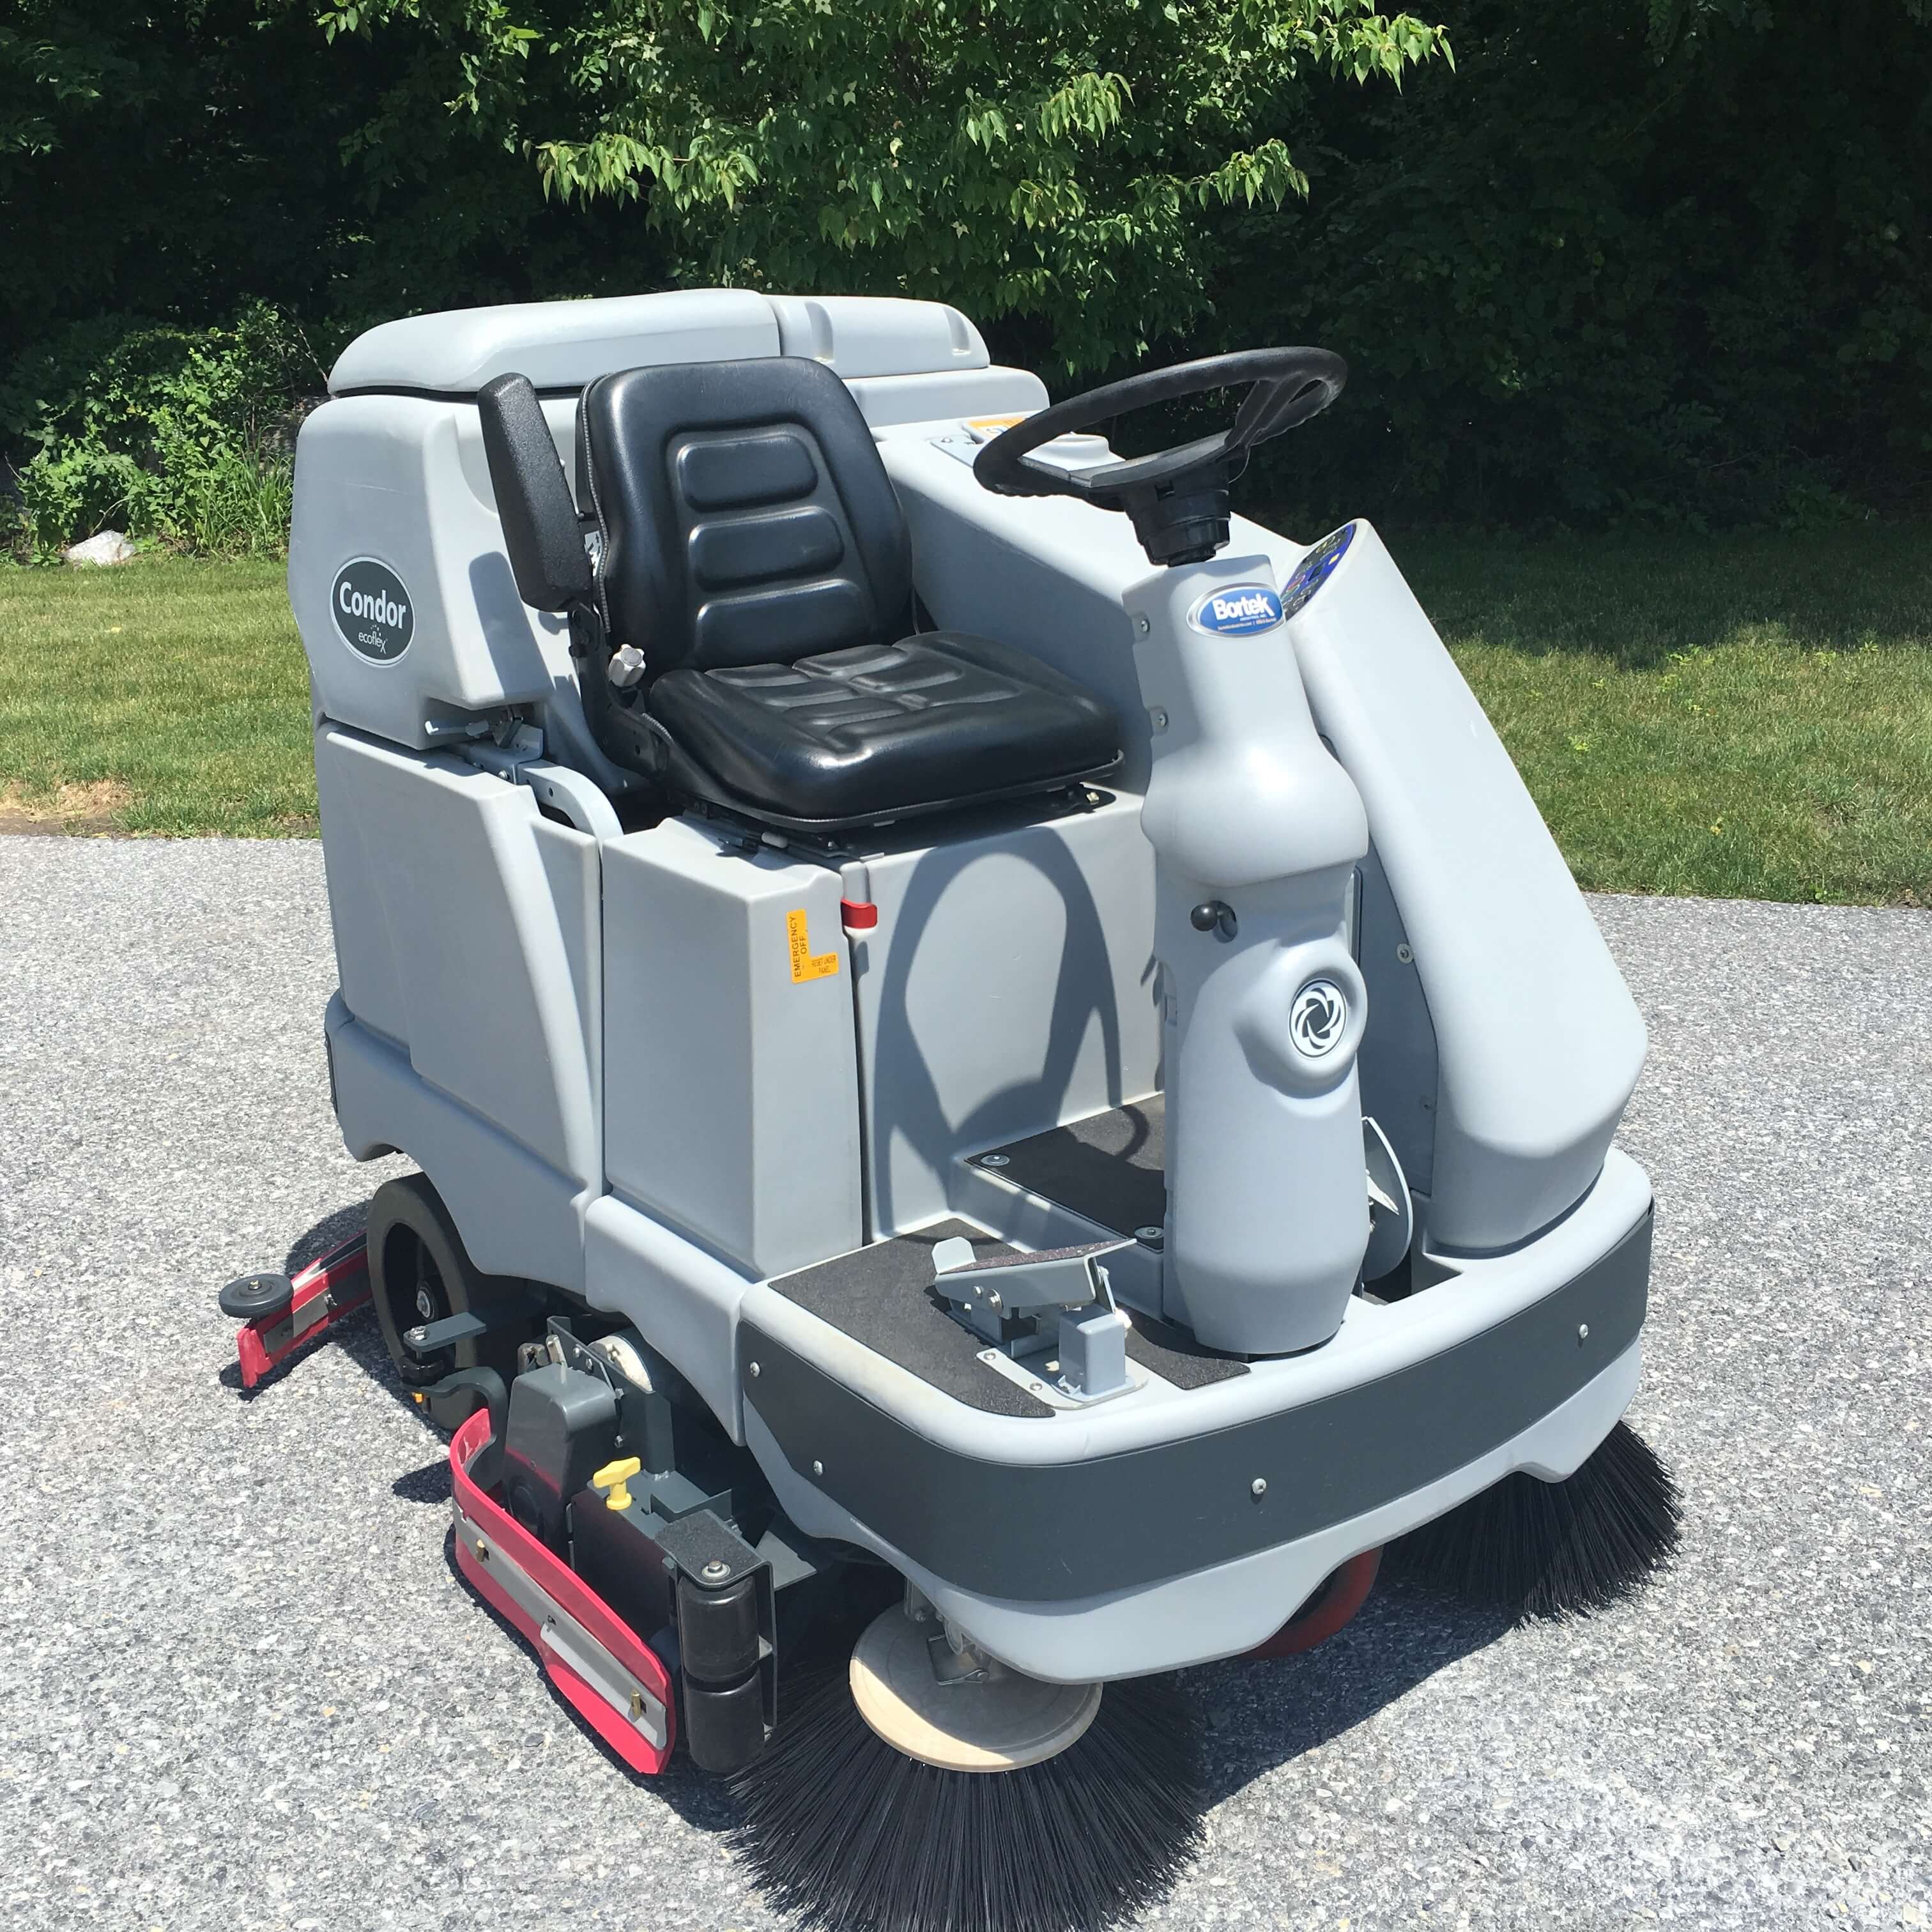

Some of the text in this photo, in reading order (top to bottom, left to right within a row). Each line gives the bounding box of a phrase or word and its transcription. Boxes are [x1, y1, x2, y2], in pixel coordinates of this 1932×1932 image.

[339, 581, 406, 629] Condor
[1212, 593, 1275, 620] Bortek
[358, 631, 387, 654] ecoflex
[790, 916, 801, 977] EMERGENCY
